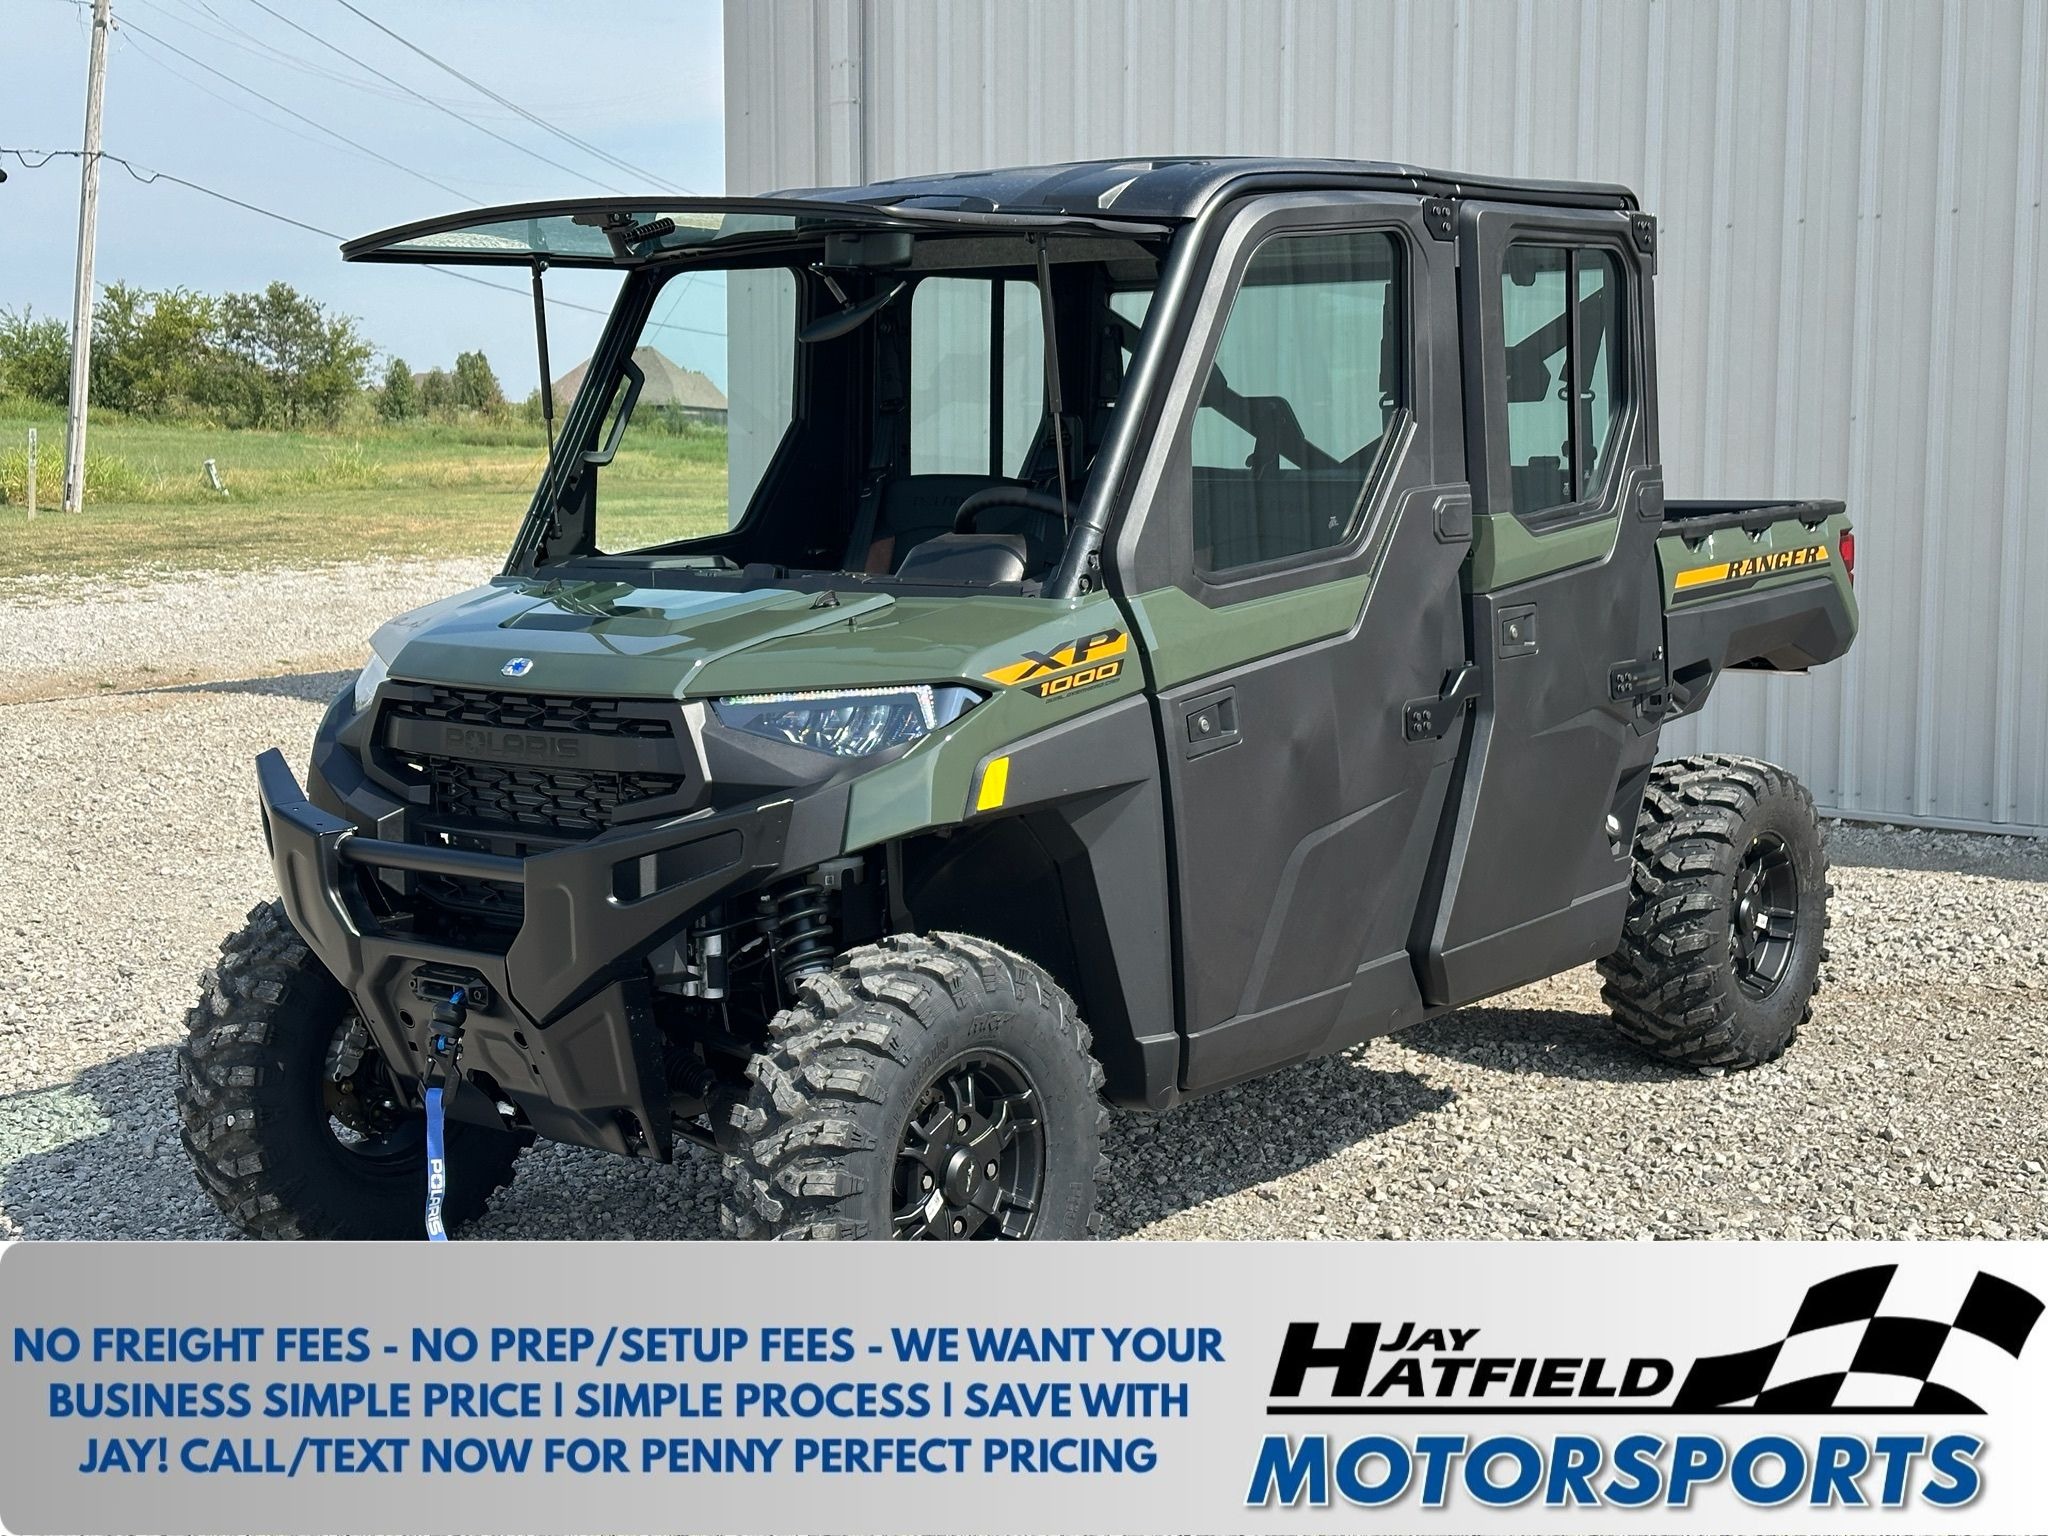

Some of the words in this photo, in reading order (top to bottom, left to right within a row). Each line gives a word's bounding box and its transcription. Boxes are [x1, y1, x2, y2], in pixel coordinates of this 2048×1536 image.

[1725, 545, 1819, 580] RANGER
[1013, 628, 1122, 681] XP
[1040, 661, 1119, 697] 1000
[446, 727, 580, 760] POLARIS
[428, 1159, 443, 1236] POLARIS
